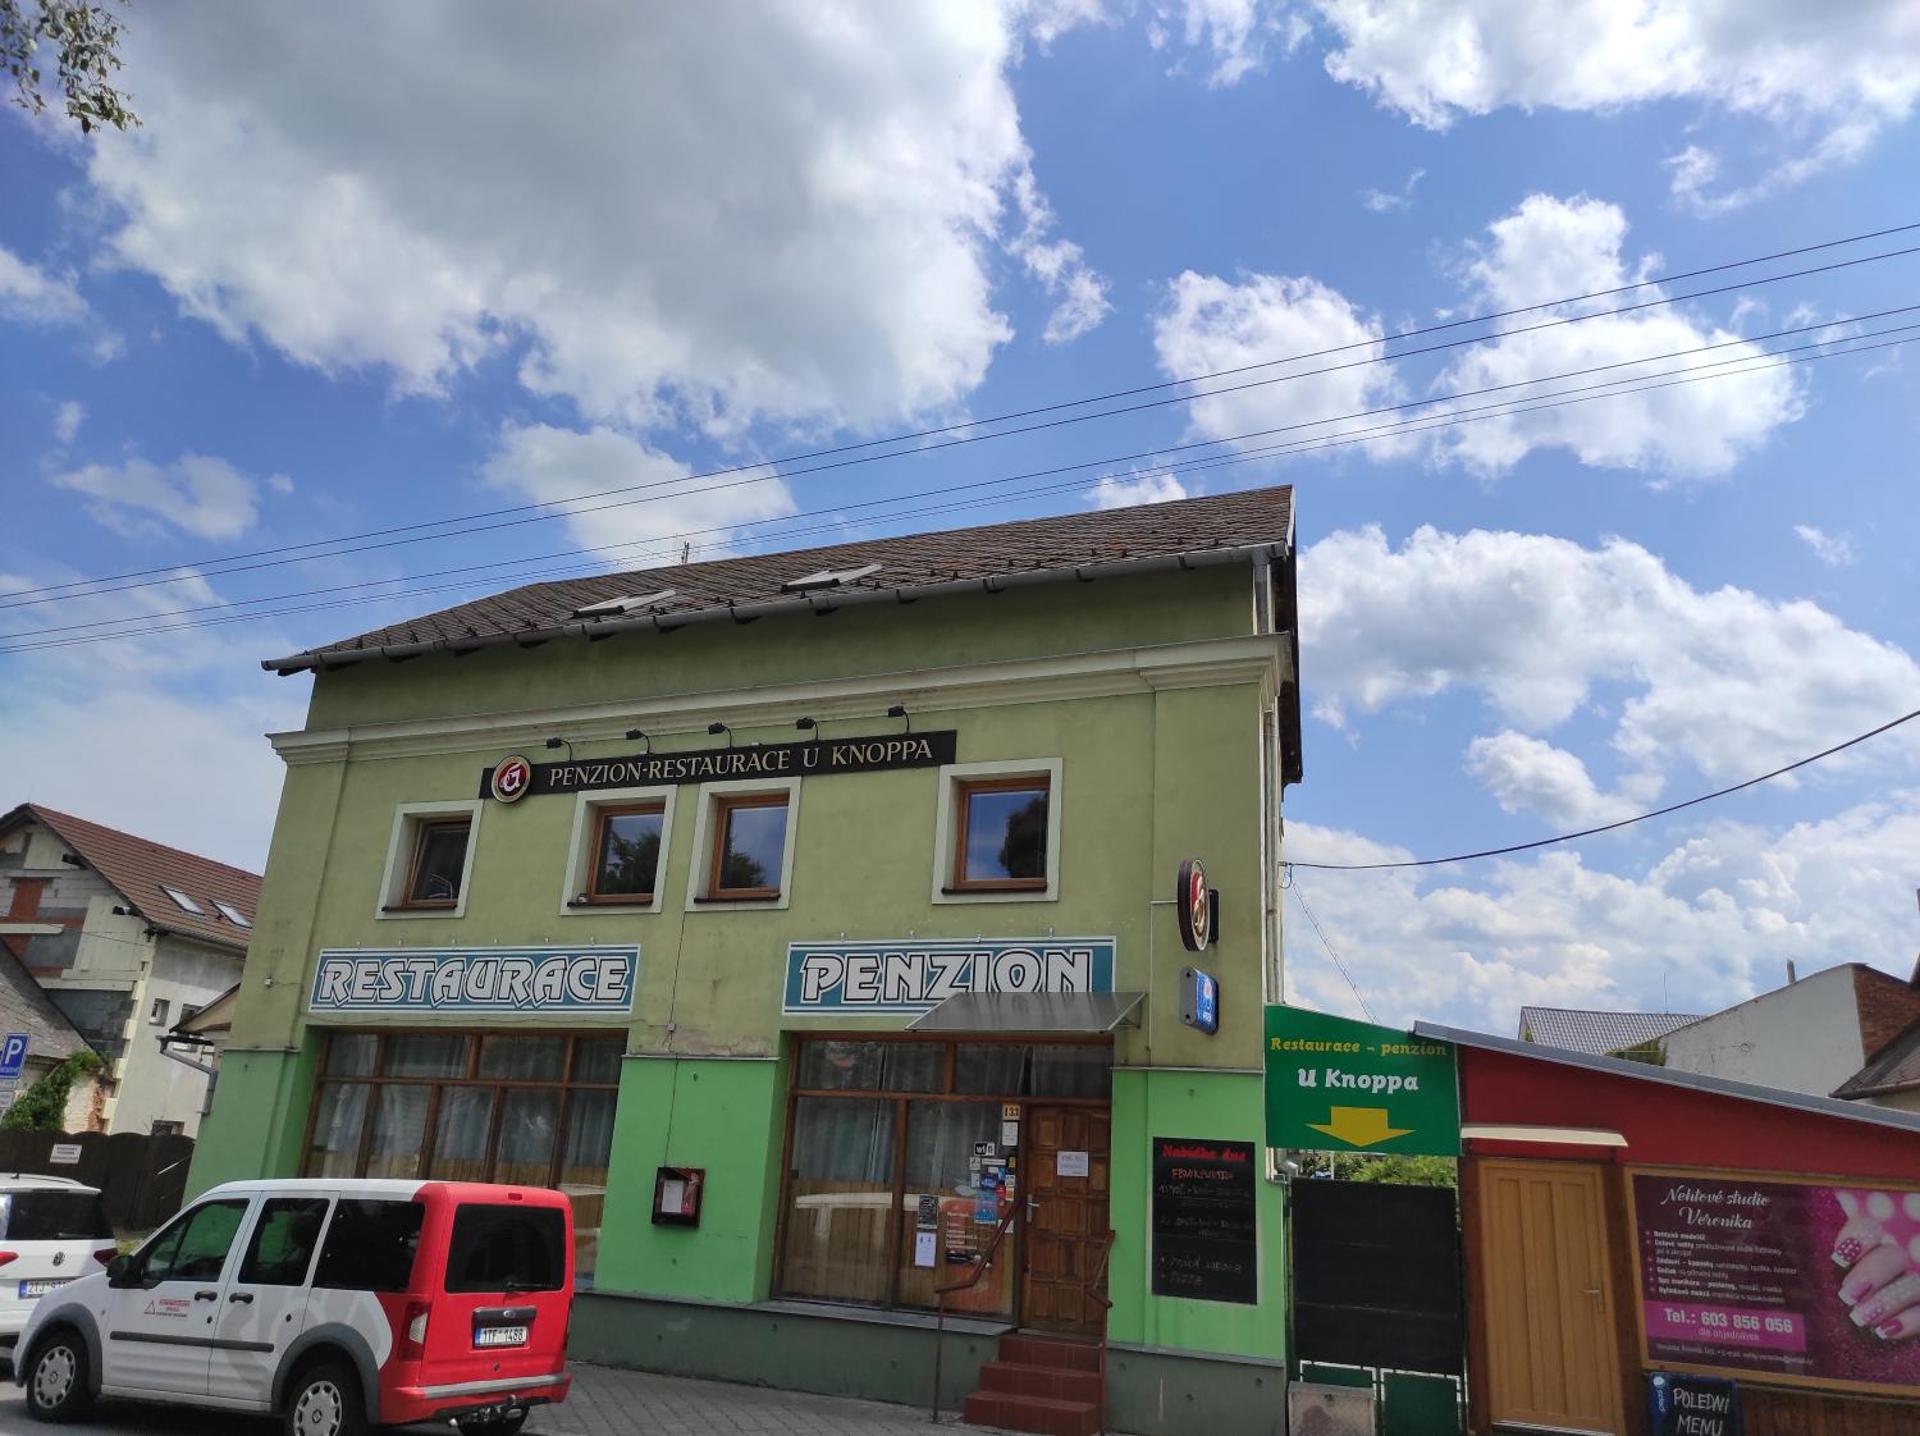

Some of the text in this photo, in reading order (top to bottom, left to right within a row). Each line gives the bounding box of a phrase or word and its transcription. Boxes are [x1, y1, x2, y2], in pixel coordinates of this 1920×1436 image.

[549, 739, 933, 787] PENZION-RESTAURACE U KNOPPA
[317, 956, 631, 1008] RESTAURACE
[801, 948, 1092, 1003] PENZION
[5, 1038, 22, 1065] P
[1270, 1037, 1361, 1053] Restaurace
[1380, 1043, 1448, 1057] penzion
[1325, 1068, 1419, 1094] Knoppa
[1660, 1184, 1770, 1206] Nehtové studio
[1679, 1206, 1752, 1229] Veronika
[1664, 1308, 1793, 1333] Tel.: 603 856 056
[1676, 1414, 1723, 1436] MENU
